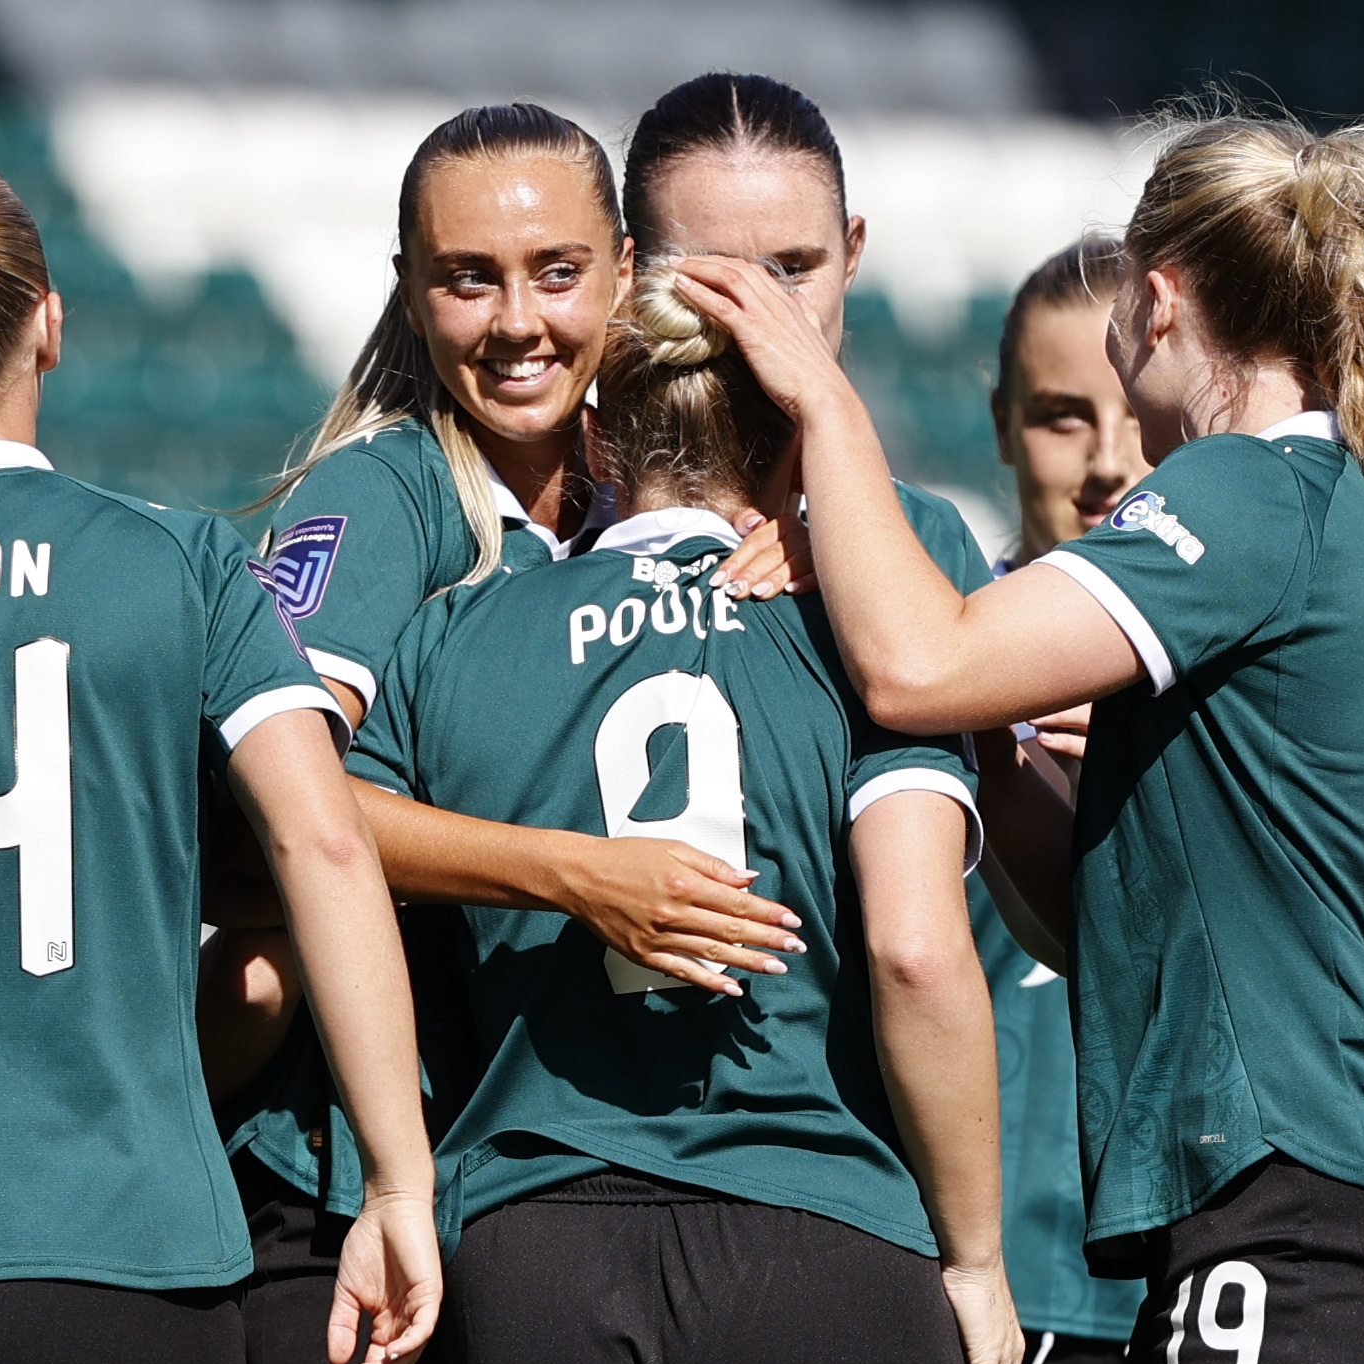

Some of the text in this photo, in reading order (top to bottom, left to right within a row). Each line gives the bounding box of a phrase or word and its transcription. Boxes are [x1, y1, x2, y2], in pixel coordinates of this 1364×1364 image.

[1117, 497, 1205, 565] extra
[569, 582, 746, 665] POOLE
[1199, 1133, 1227, 1145] DRYCELL
